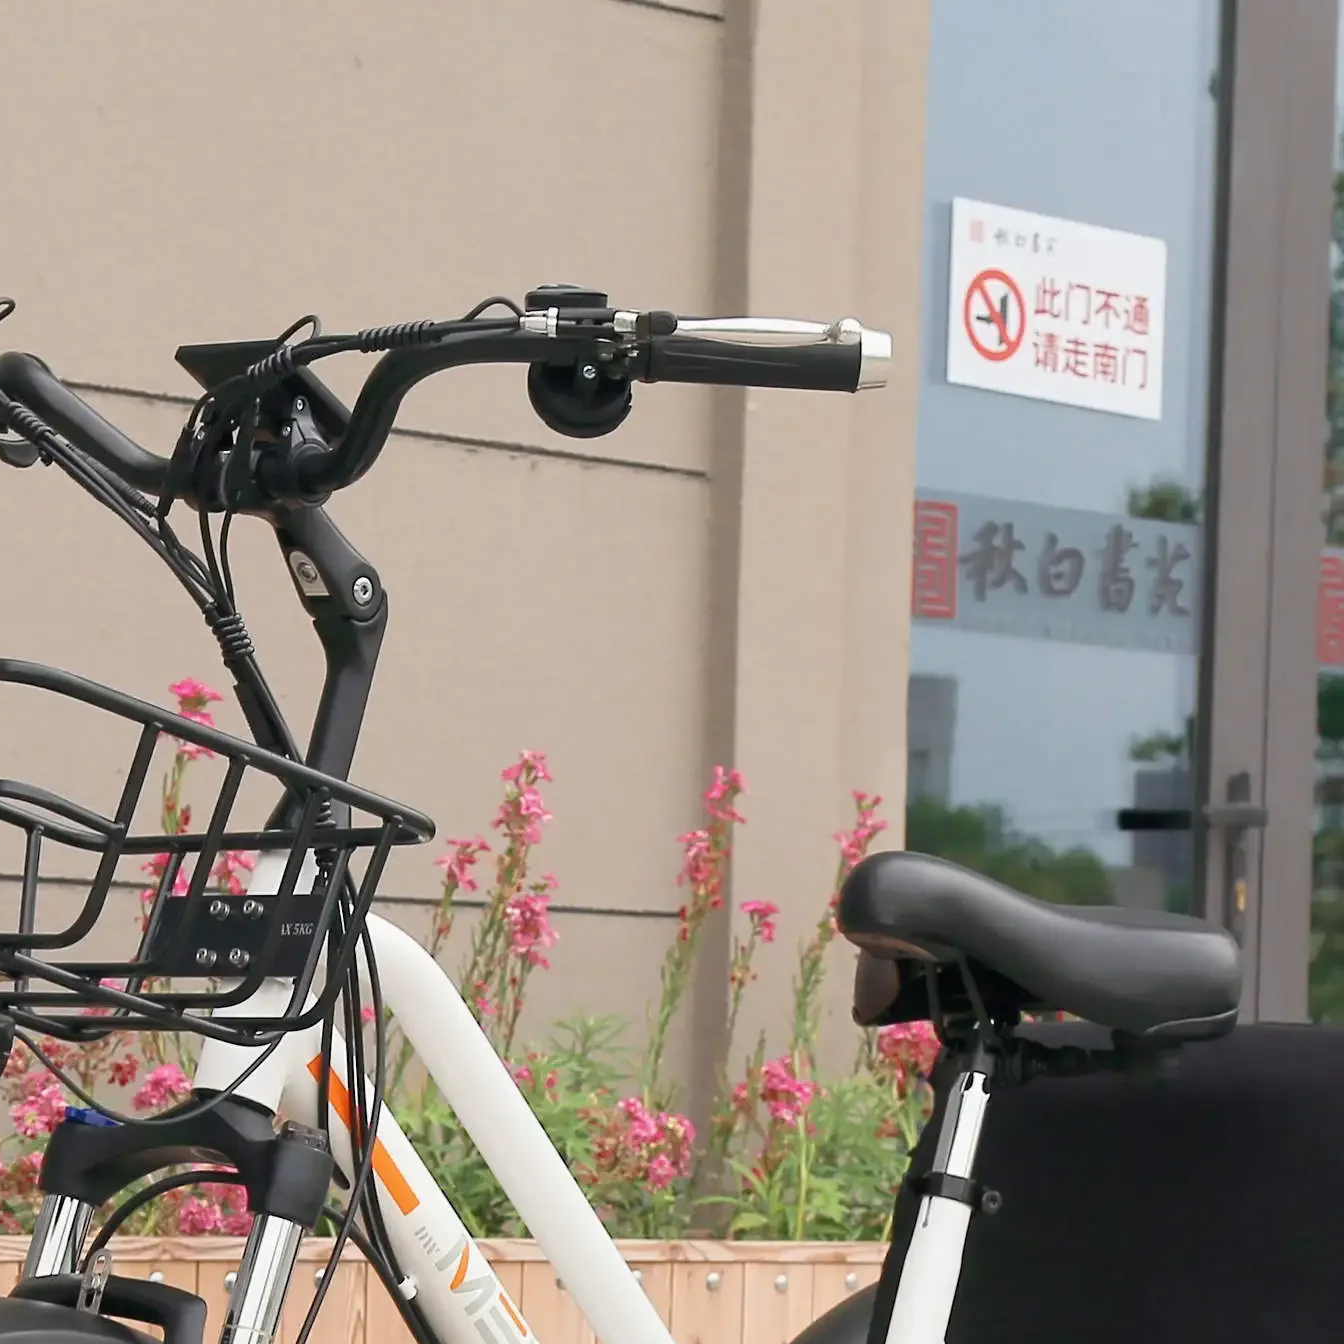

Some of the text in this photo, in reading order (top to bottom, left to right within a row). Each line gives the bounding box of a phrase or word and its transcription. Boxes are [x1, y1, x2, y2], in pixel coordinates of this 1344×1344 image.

[1034, 276, 1150, 336] 此门不通
[1032, 329, 1149, 390] 请走南门
